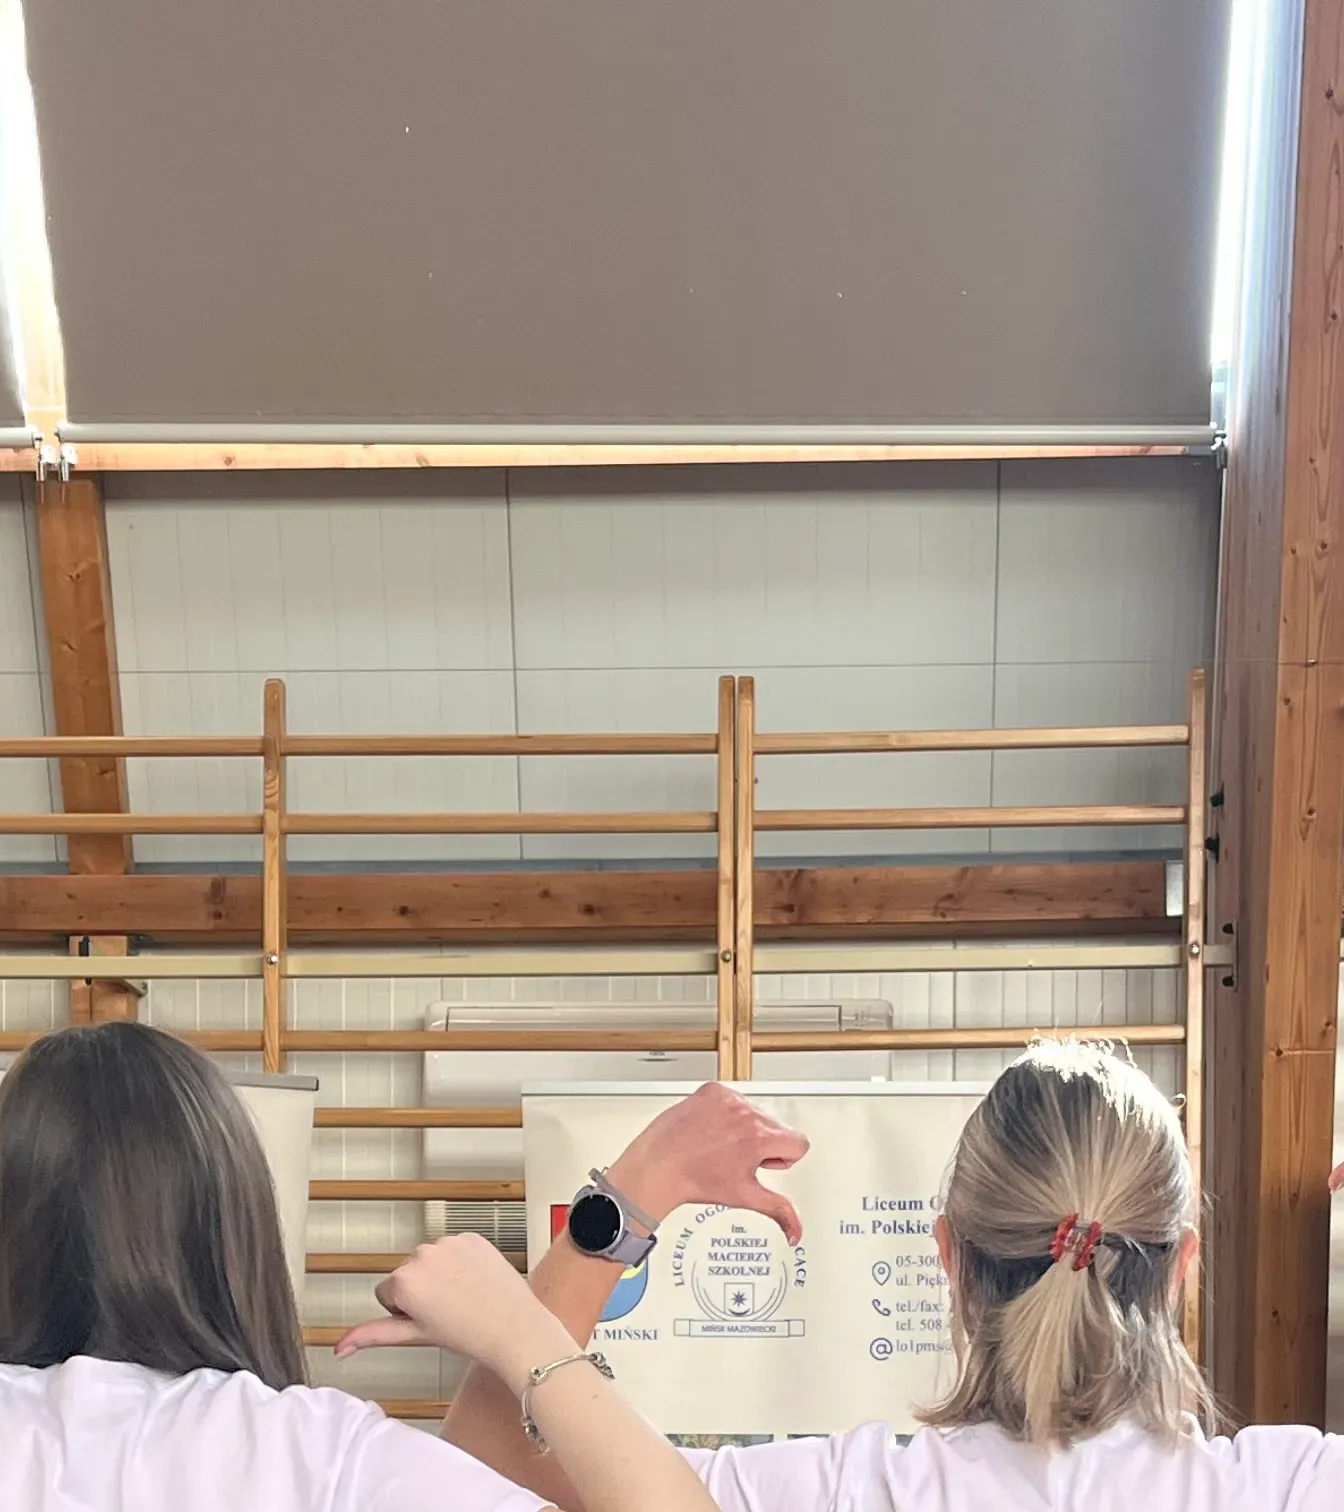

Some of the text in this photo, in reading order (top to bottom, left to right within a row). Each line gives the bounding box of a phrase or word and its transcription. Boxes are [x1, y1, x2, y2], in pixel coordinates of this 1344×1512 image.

[862, 1196, 924, 1211] Liceum
[839, 1220, 866, 1235] im.
[710, 1238, 768, 1248] POLSKIEJ
[671, 1227, 694, 1288] LICEUM
[707, 1252, 772, 1263] MACIERZY
[707, 1266, 771, 1277] SZKOLNEJ
[895, 1274, 911, 1286] ul.
[895, 1319, 943, 1331] tel. 508
[605, 1326, 659, 1341] MIŃSKI
